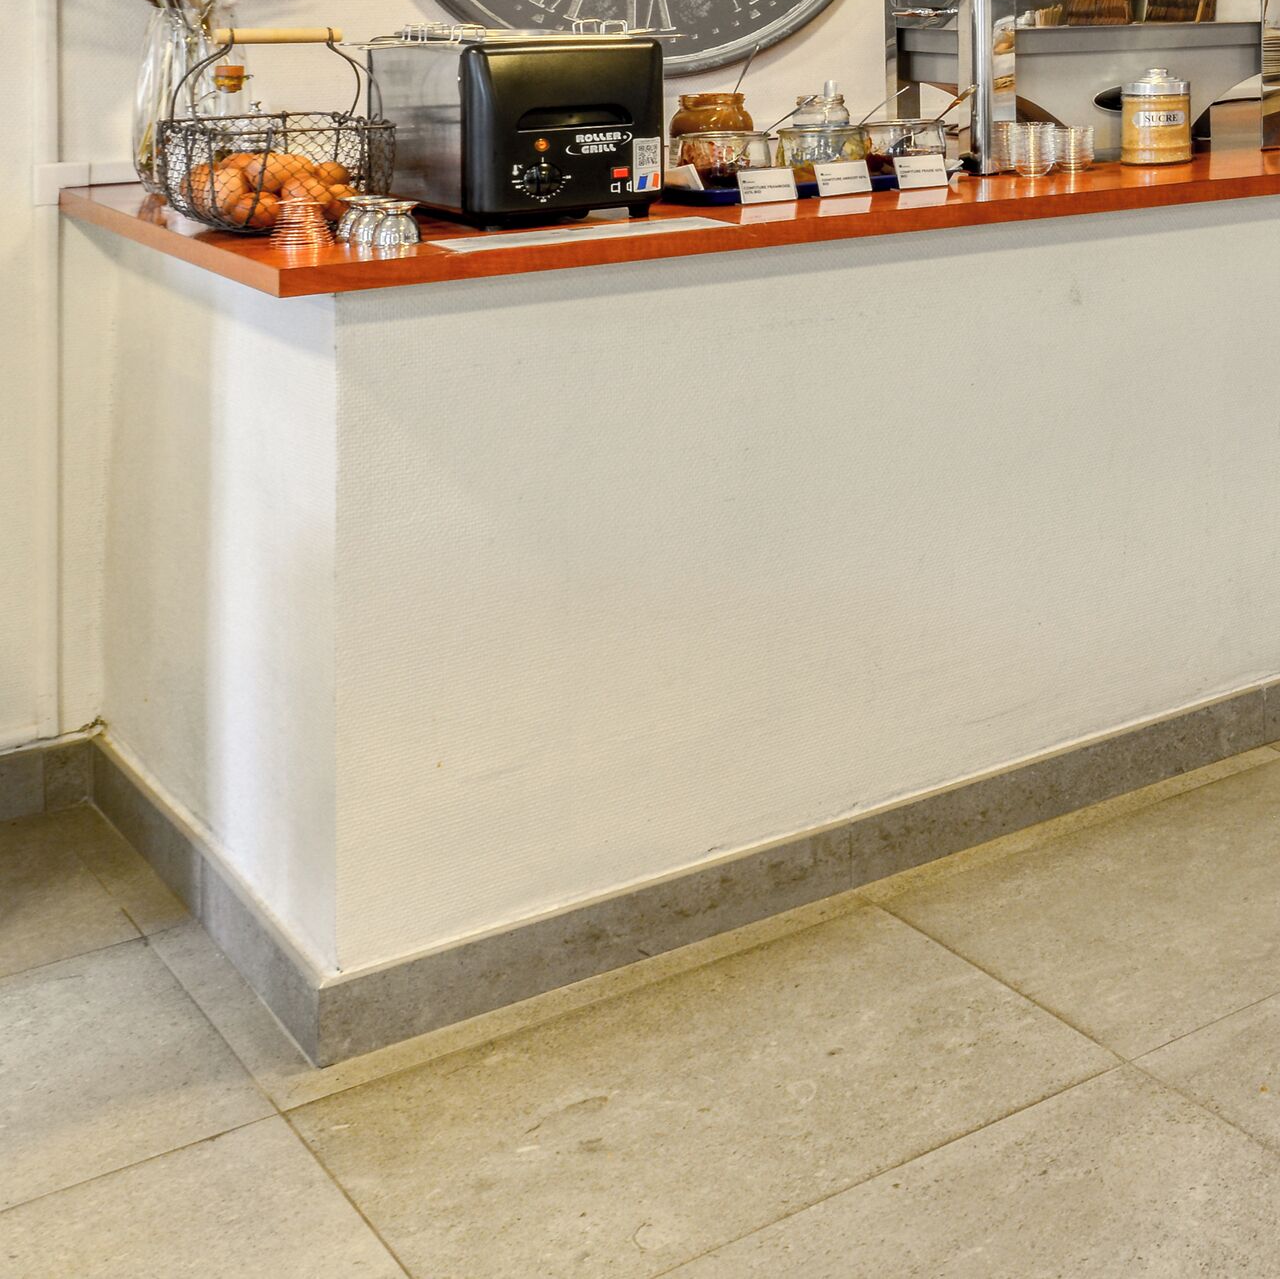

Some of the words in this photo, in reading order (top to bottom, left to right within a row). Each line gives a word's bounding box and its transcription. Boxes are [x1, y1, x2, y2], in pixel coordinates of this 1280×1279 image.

[1144, 113, 1178, 123] SUCRE
[575, 131, 622, 144] ROLLER
[581, 142, 617, 155] GRILL
